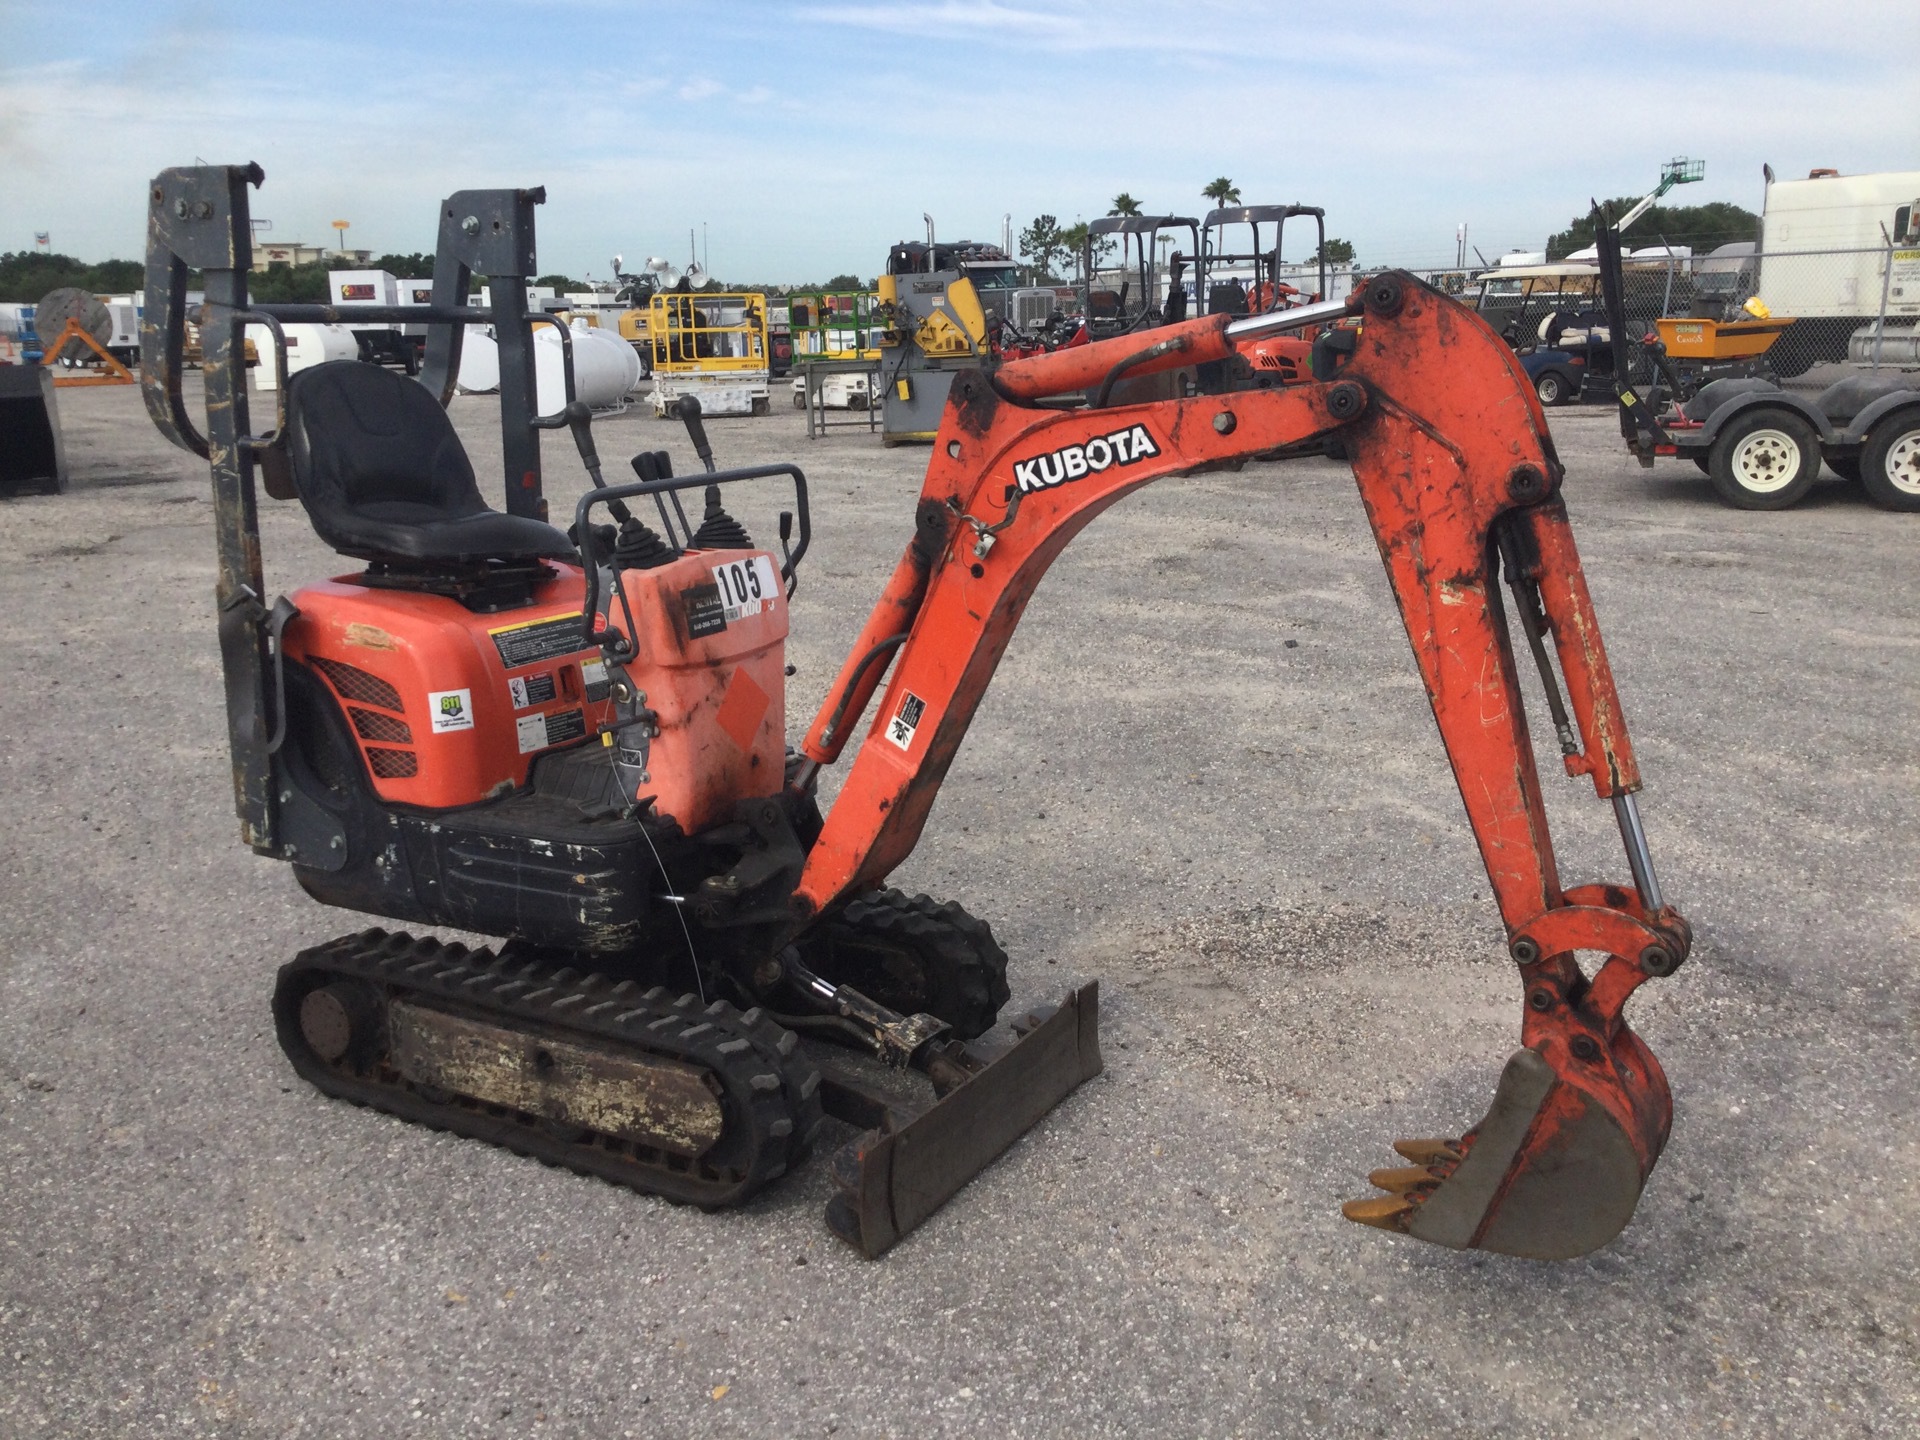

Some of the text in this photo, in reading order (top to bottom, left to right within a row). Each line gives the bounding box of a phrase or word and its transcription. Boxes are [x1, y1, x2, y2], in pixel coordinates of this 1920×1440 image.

[1015, 426, 1156, 491] KUBOTA
[718, 559, 762, 606] 105
[441, 695, 460, 710] 811
